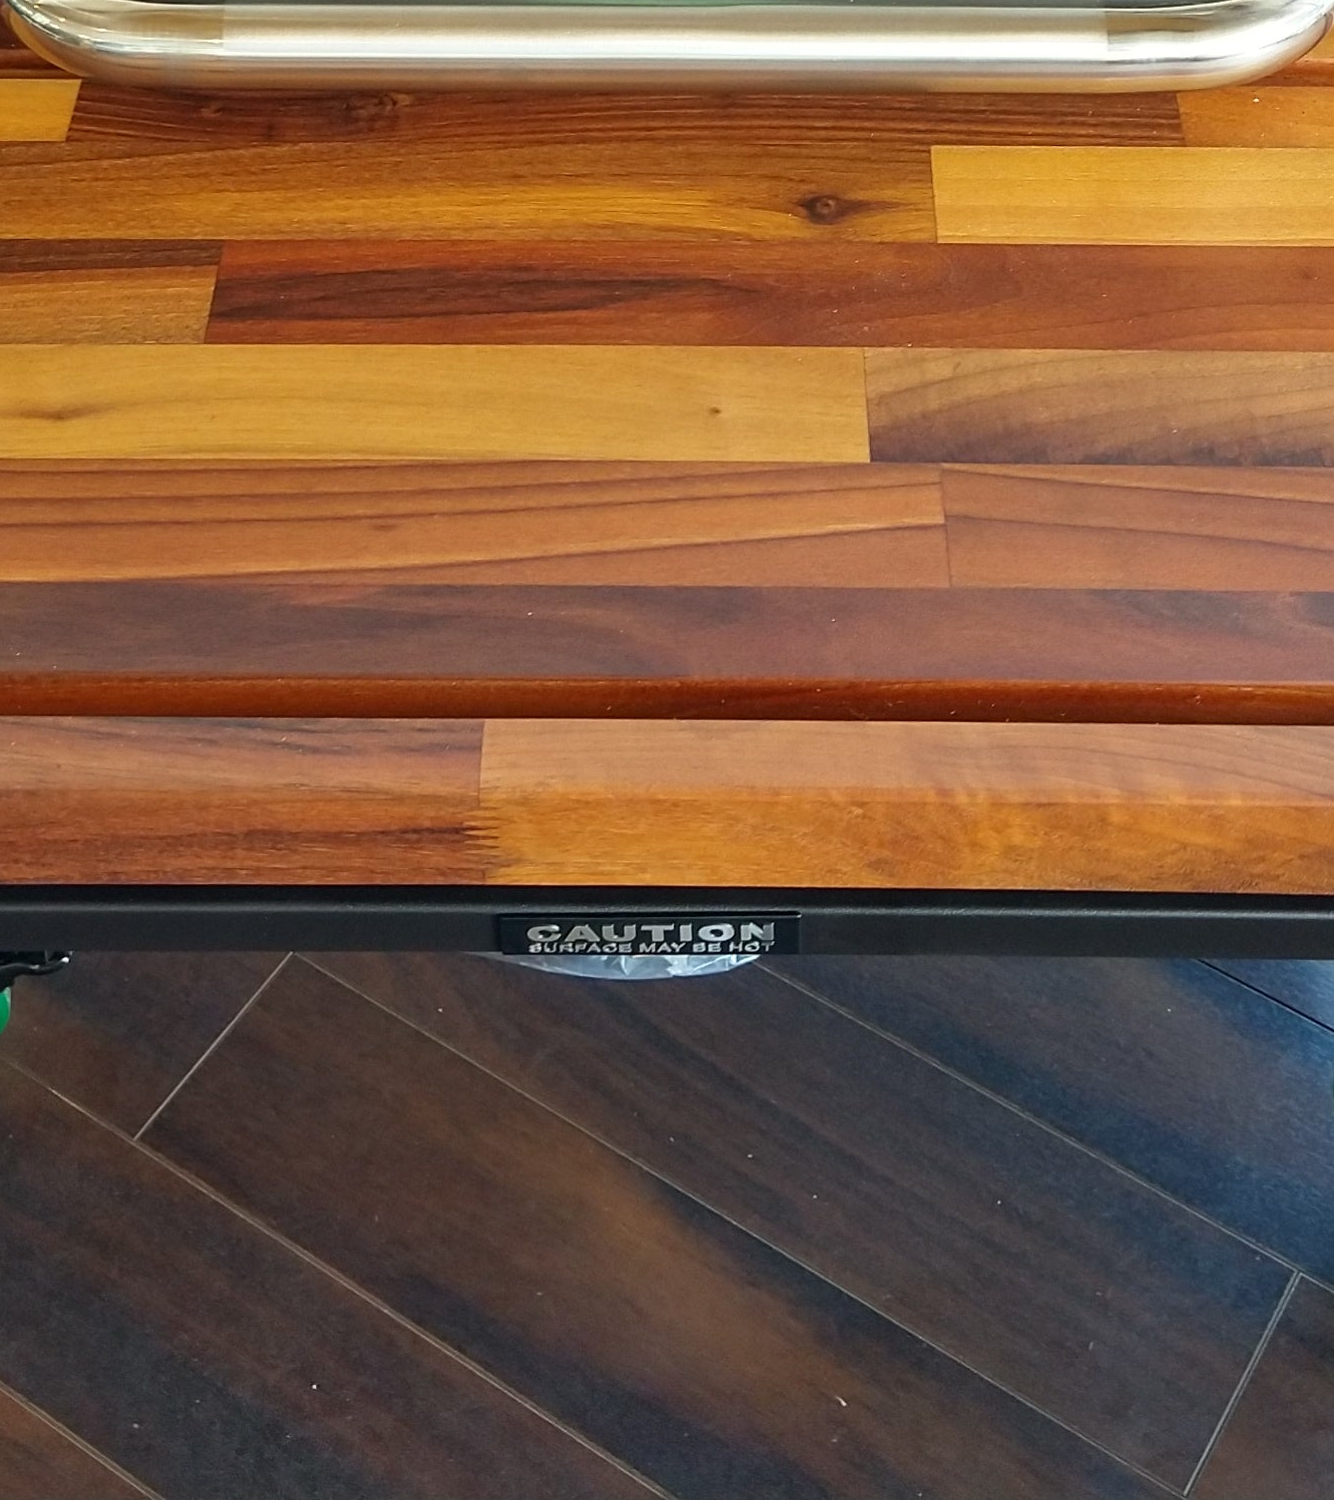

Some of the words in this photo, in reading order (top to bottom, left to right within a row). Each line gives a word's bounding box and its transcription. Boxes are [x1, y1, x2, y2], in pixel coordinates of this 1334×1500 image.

[527, 922, 775, 943] CAUTION
[528, 943, 632, 954] SURFACE
[639, 942, 686, 954] MAY
[693, 942, 722, 954] BE
[729, 941, 776, 953] HOT
